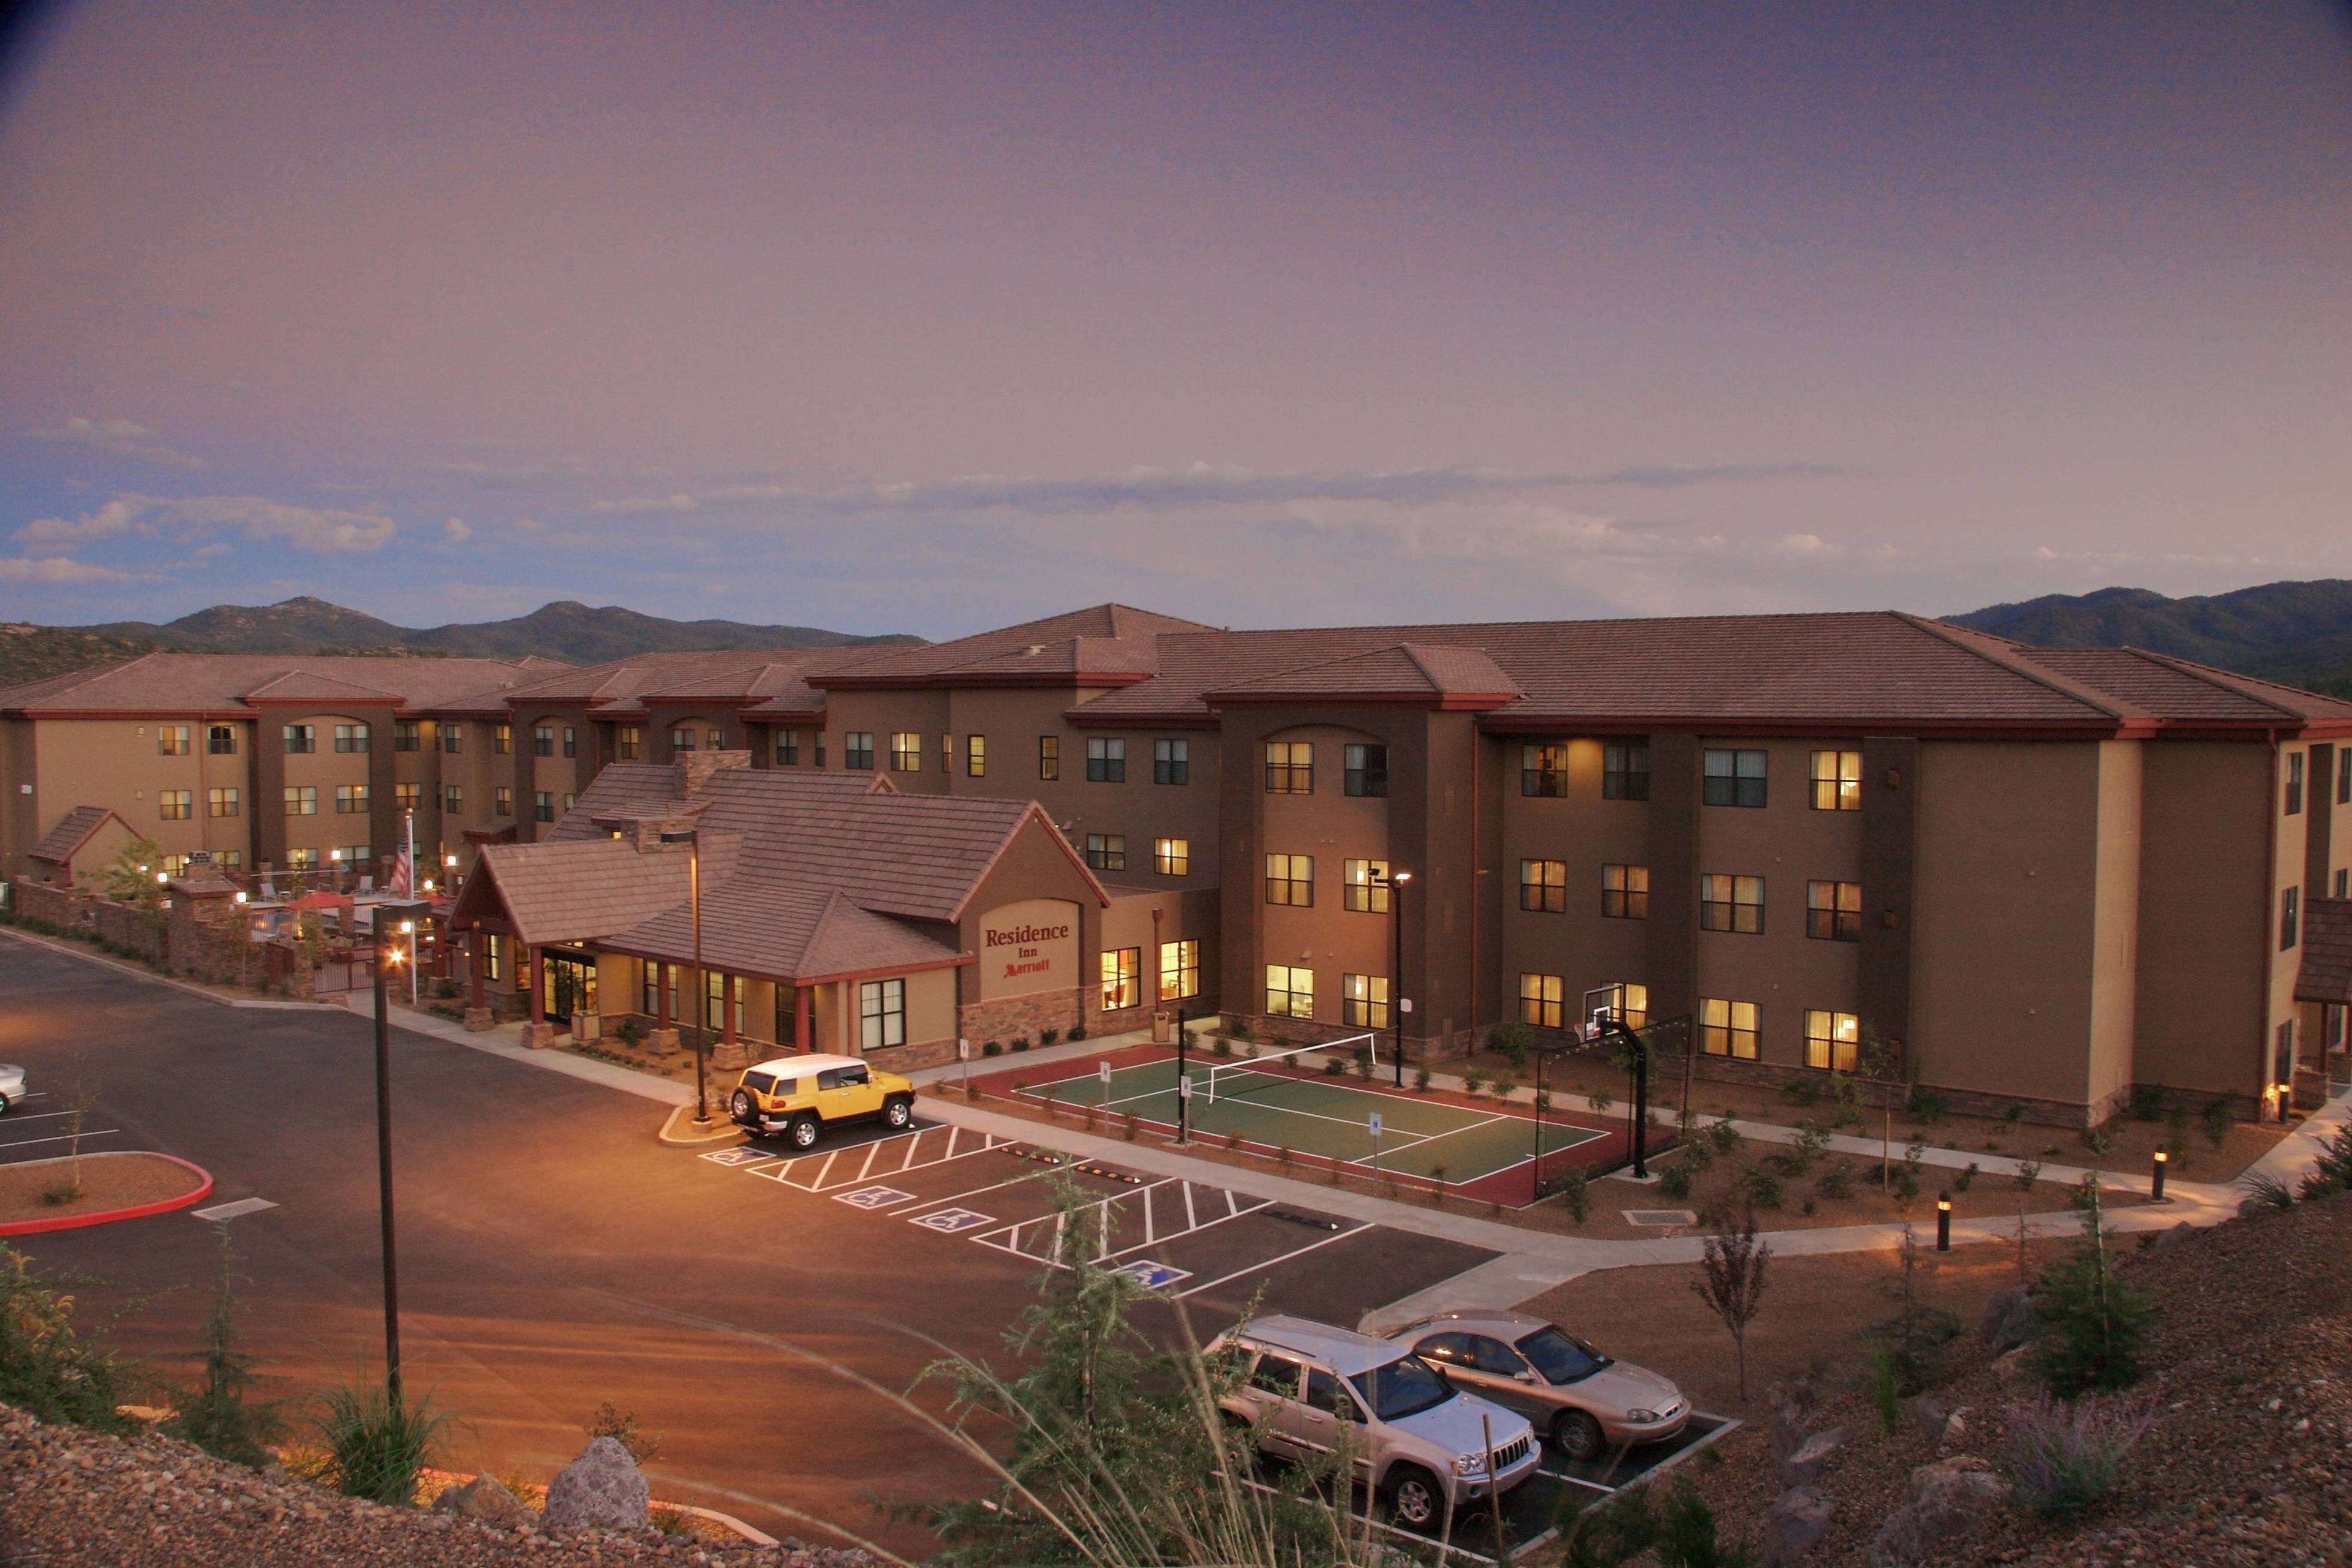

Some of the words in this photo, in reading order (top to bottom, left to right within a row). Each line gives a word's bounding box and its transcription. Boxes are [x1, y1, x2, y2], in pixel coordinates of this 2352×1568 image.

[986, 925, 1069, 947] Residence
[1019, 948, 1038, 959] Inn
[1003, 959, 1049, 978] Marriott
